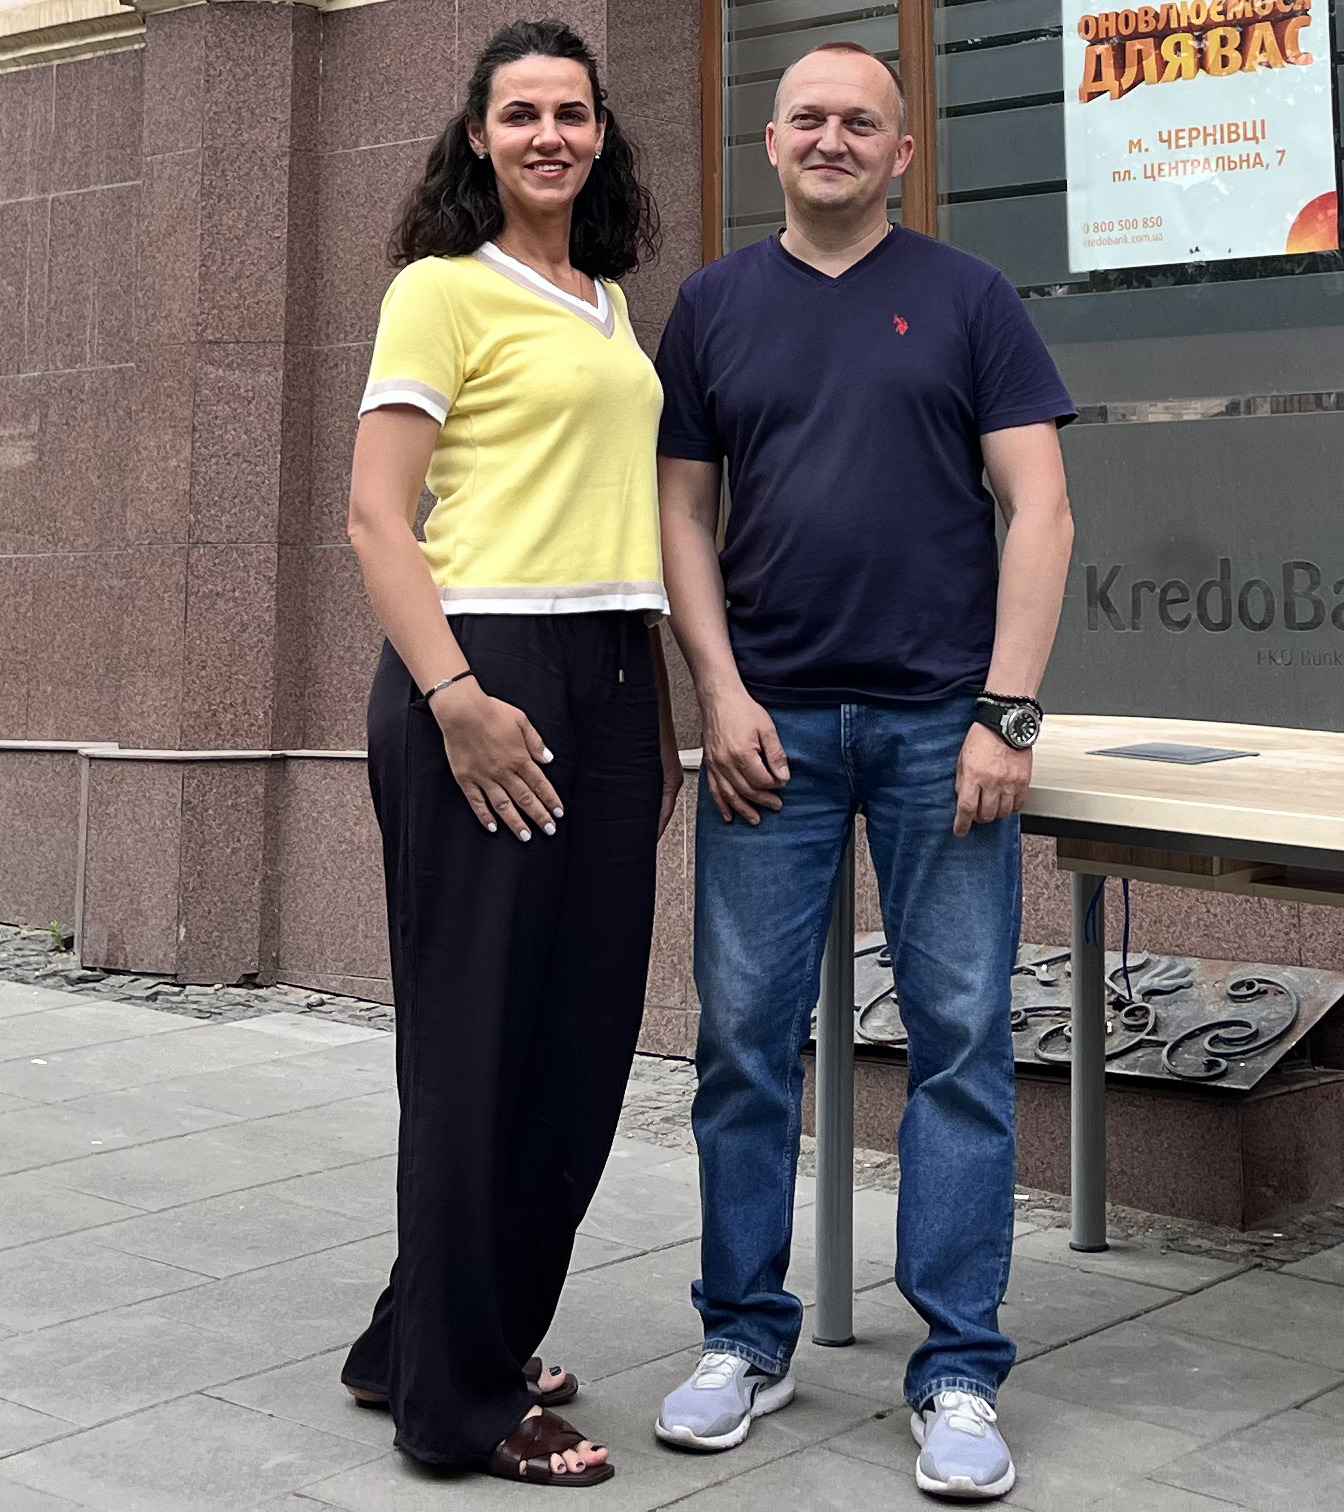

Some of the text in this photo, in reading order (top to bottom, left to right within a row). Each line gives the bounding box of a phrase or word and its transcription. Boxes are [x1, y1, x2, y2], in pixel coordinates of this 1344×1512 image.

[1078, 15, 1314, 103] ДЛЯ ВАС
[1158, 118, 1266, 151] ЧЕРНІВЦІ
[1143, 151, 1271, 182] ЦЕНТРАЛЬНА,
[1275, 148, 1287, 166] 7
[1092, 220, 1115, 234] 800
[1117, 218, 1139, 231] 500
[1142, 215, 1163, 229] 850
